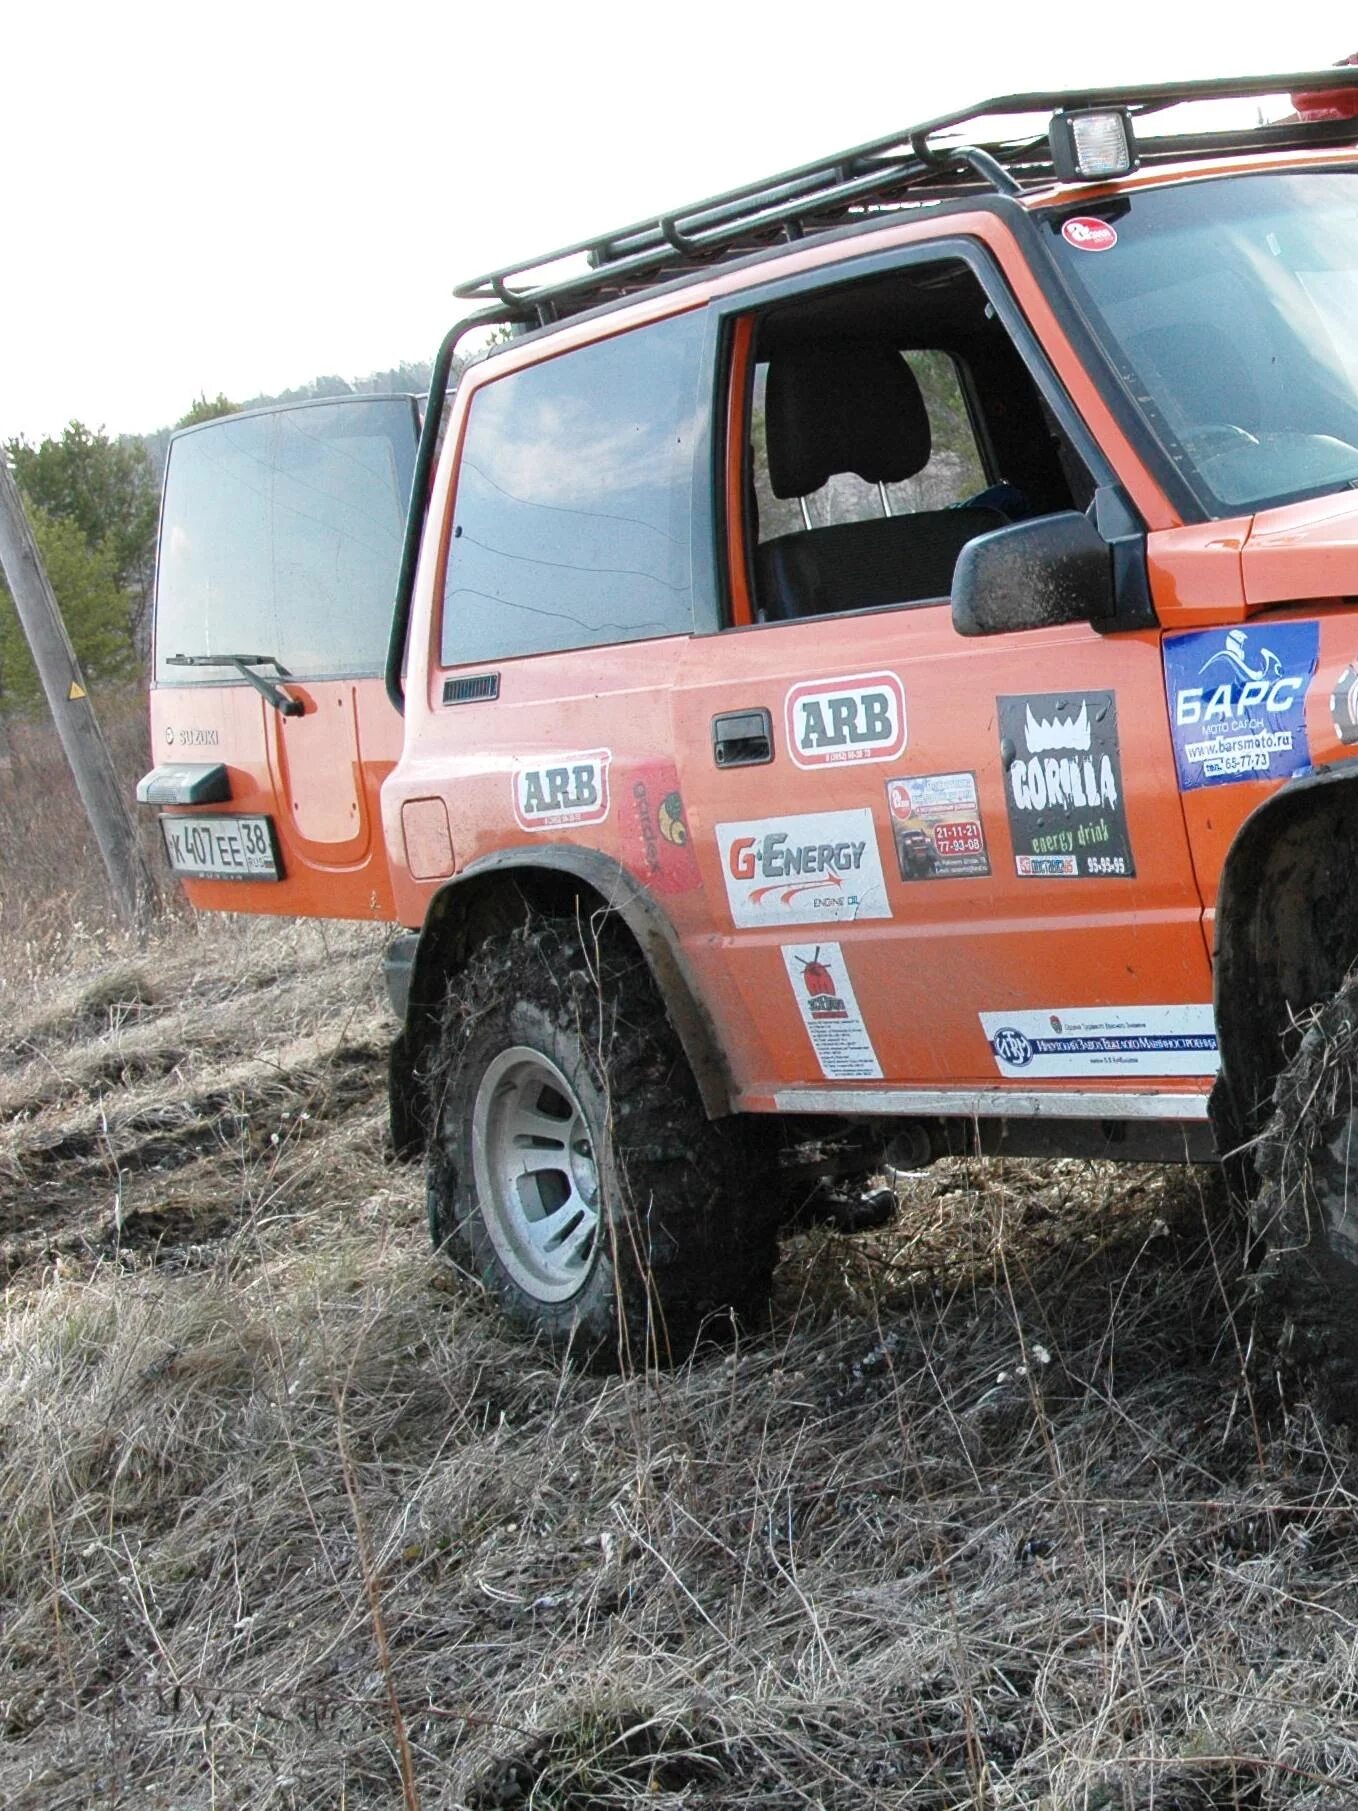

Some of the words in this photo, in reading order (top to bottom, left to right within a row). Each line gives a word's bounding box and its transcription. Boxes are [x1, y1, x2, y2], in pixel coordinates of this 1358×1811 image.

[1177, 677, 1303, 726] БАРС
[179, 729, 219, 745] SUZUKI
[800, 692, 893, 750] ARB
[1188, 734, 1291, 759] www.barsmoto.ru
[523, 764, 598, 814] ARB
[1011, 753, 1118, 811] GORILLA
[241, 823, 268, 855] 38
[936, 825, 978, 839] 21-11-21
[1032, 831, 1074, 854] energy
[1077, 818, 1109, 846] drink
[813, 895, 845, 908] ENGINE
